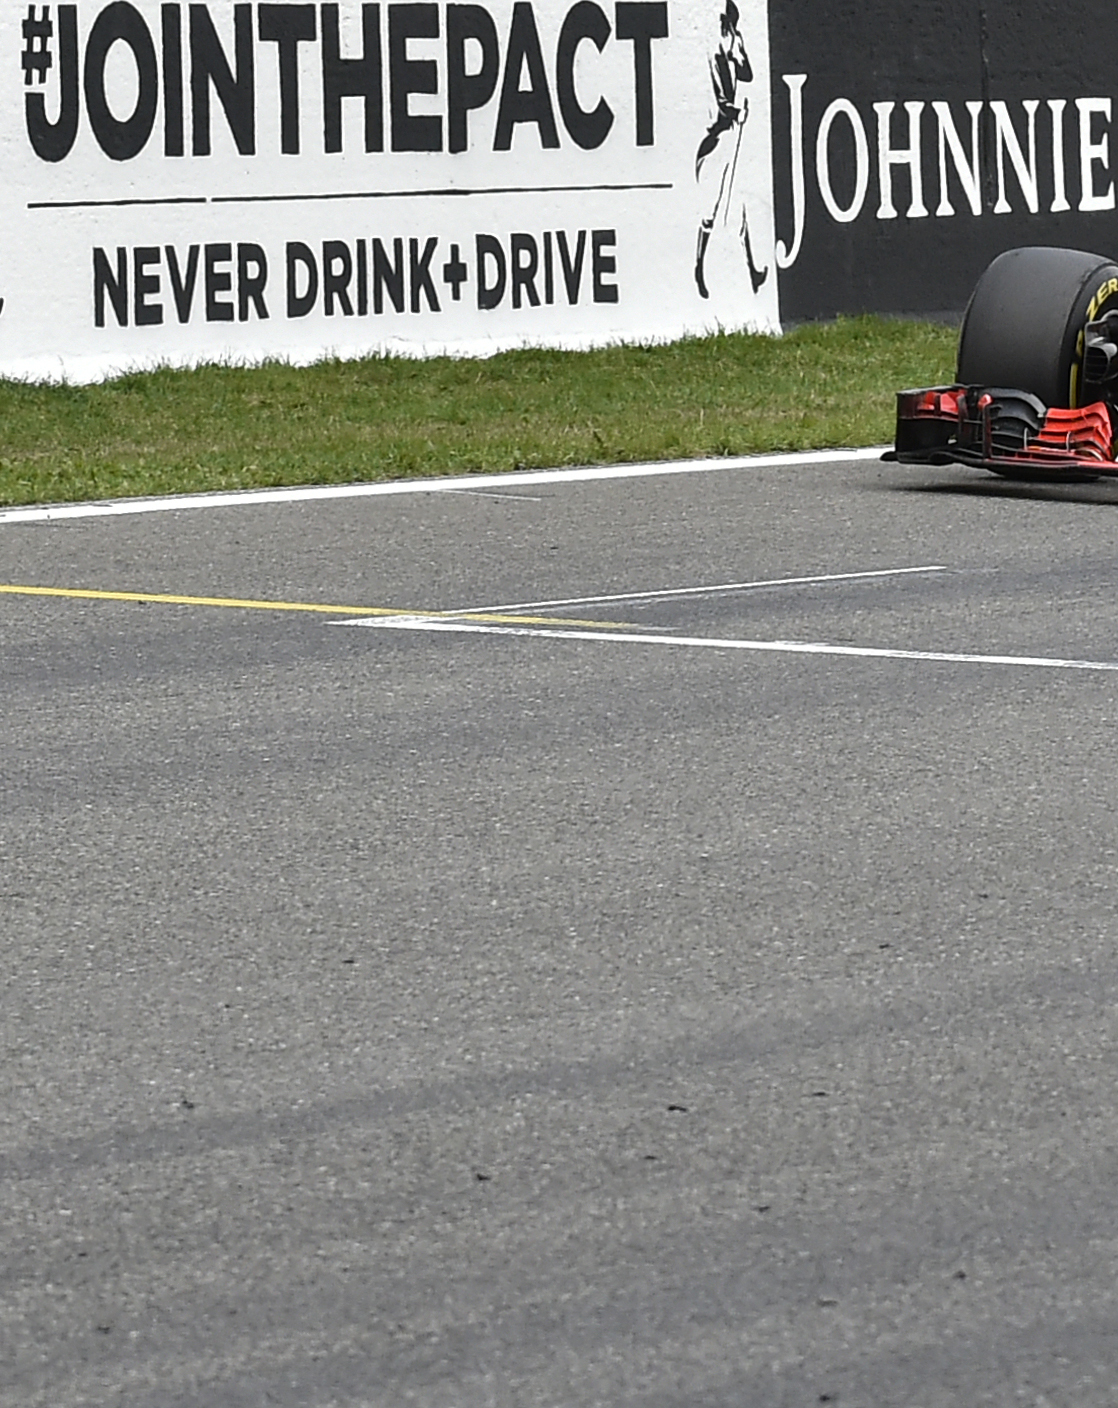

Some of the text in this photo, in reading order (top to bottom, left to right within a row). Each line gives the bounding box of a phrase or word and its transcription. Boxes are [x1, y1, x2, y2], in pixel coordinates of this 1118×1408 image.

[776, 73, 1116, 269] JOHNNIE
[93, 228, 620, 328] NEVER DRINK+DRIVE
